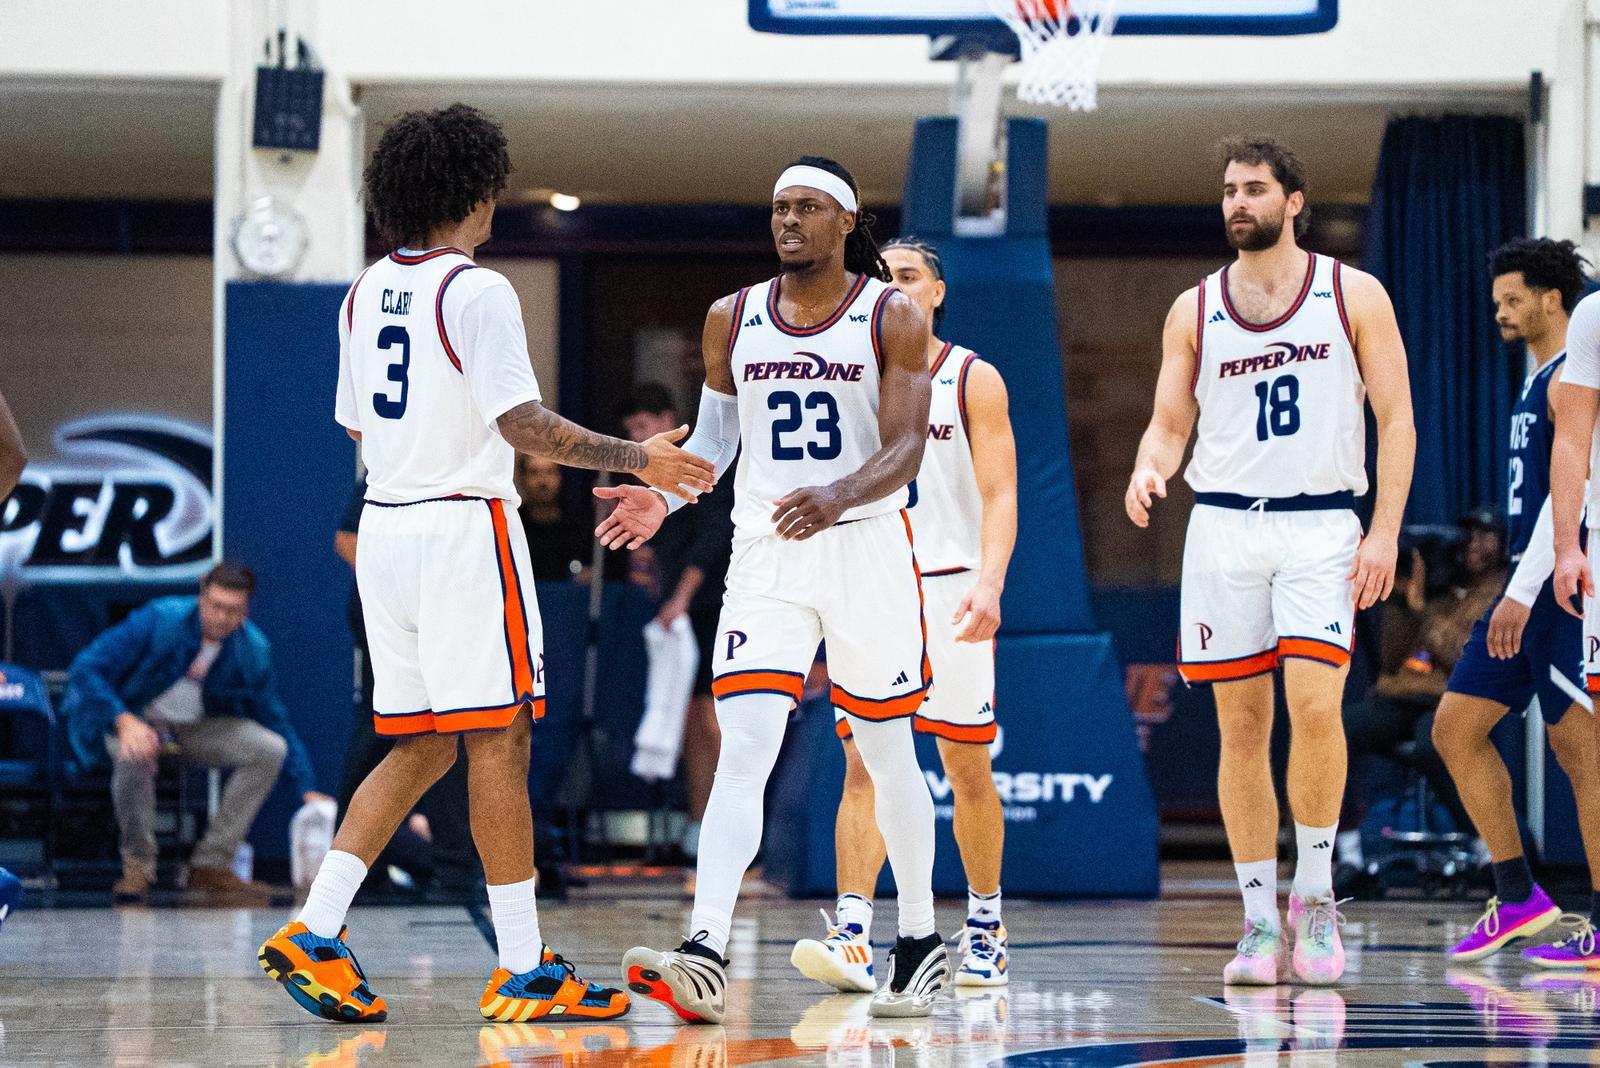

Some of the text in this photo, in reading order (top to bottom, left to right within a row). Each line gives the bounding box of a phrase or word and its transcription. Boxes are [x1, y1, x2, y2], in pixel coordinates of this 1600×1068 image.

[373, 325, 410, 419] 3
[743, 351, 865, 382] PEPPERDINE
[1219, 341, 1330, 379] PEPPERDINE
[1254, 374, 1300, 441] 18
[767, 390, 842, 460] 23
[723, 630, 747, 661] P
[1192, 622, 1213, 650] P
[1586, 635, 1600, 663] P
[923, 770, 1113, 803] VRSITY
